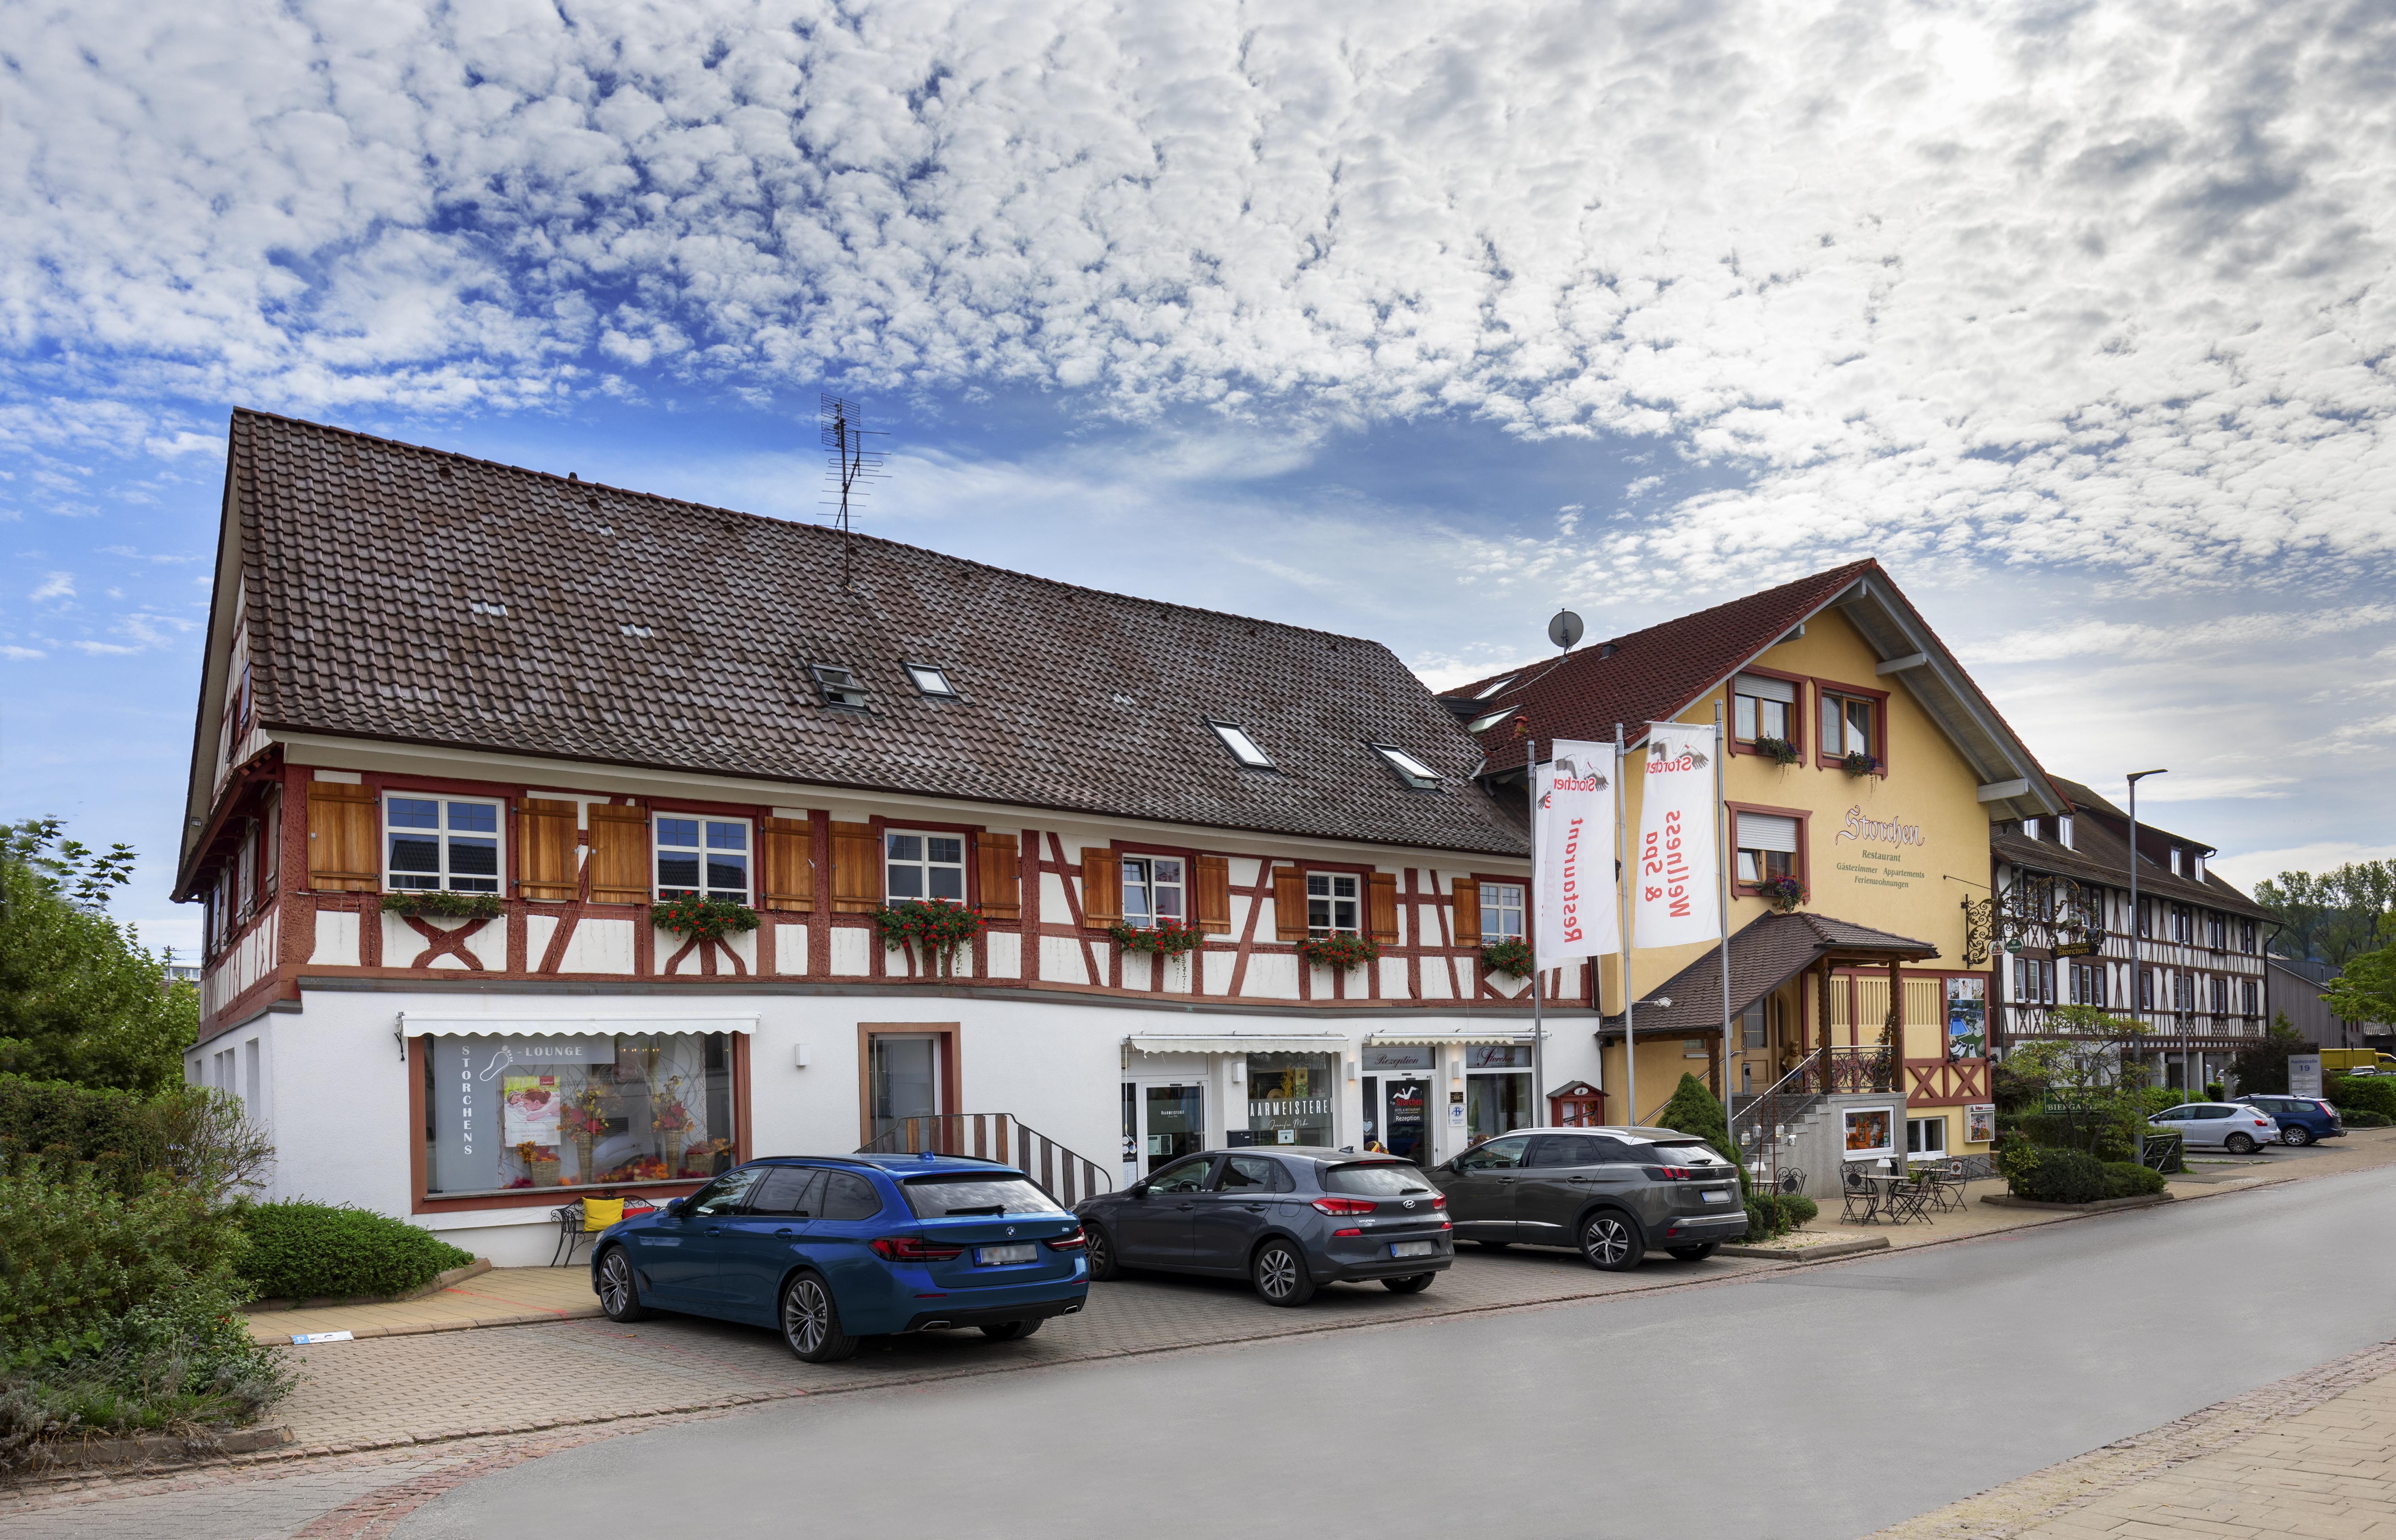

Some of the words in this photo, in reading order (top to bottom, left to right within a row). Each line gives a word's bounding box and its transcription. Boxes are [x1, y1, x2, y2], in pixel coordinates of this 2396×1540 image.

[1835, 805, 1925, 849] Storchen
[1862, 850, 1901, 862] Restaurant
[1837, 862, 1878, 874] Gästezimmer
[1883, 867, 1925, 879] Appartements
[1854, 876, 1909, 889] Ferienwohnungen
[526, 1046, 583, 1056] LOUNGE
[1477, 1047, 1515, 1068] Storchen
[1374, 1053, 1419, 1068] Rezeption
[462, 1046, 472, 1154] STORCHENS
[1250, 1097, 1332, 1117] AARMEISTEREI
[1396, 1098, 1423, 1106] Storchen
[1269, 1119, 1291, 1130] Jennifer
